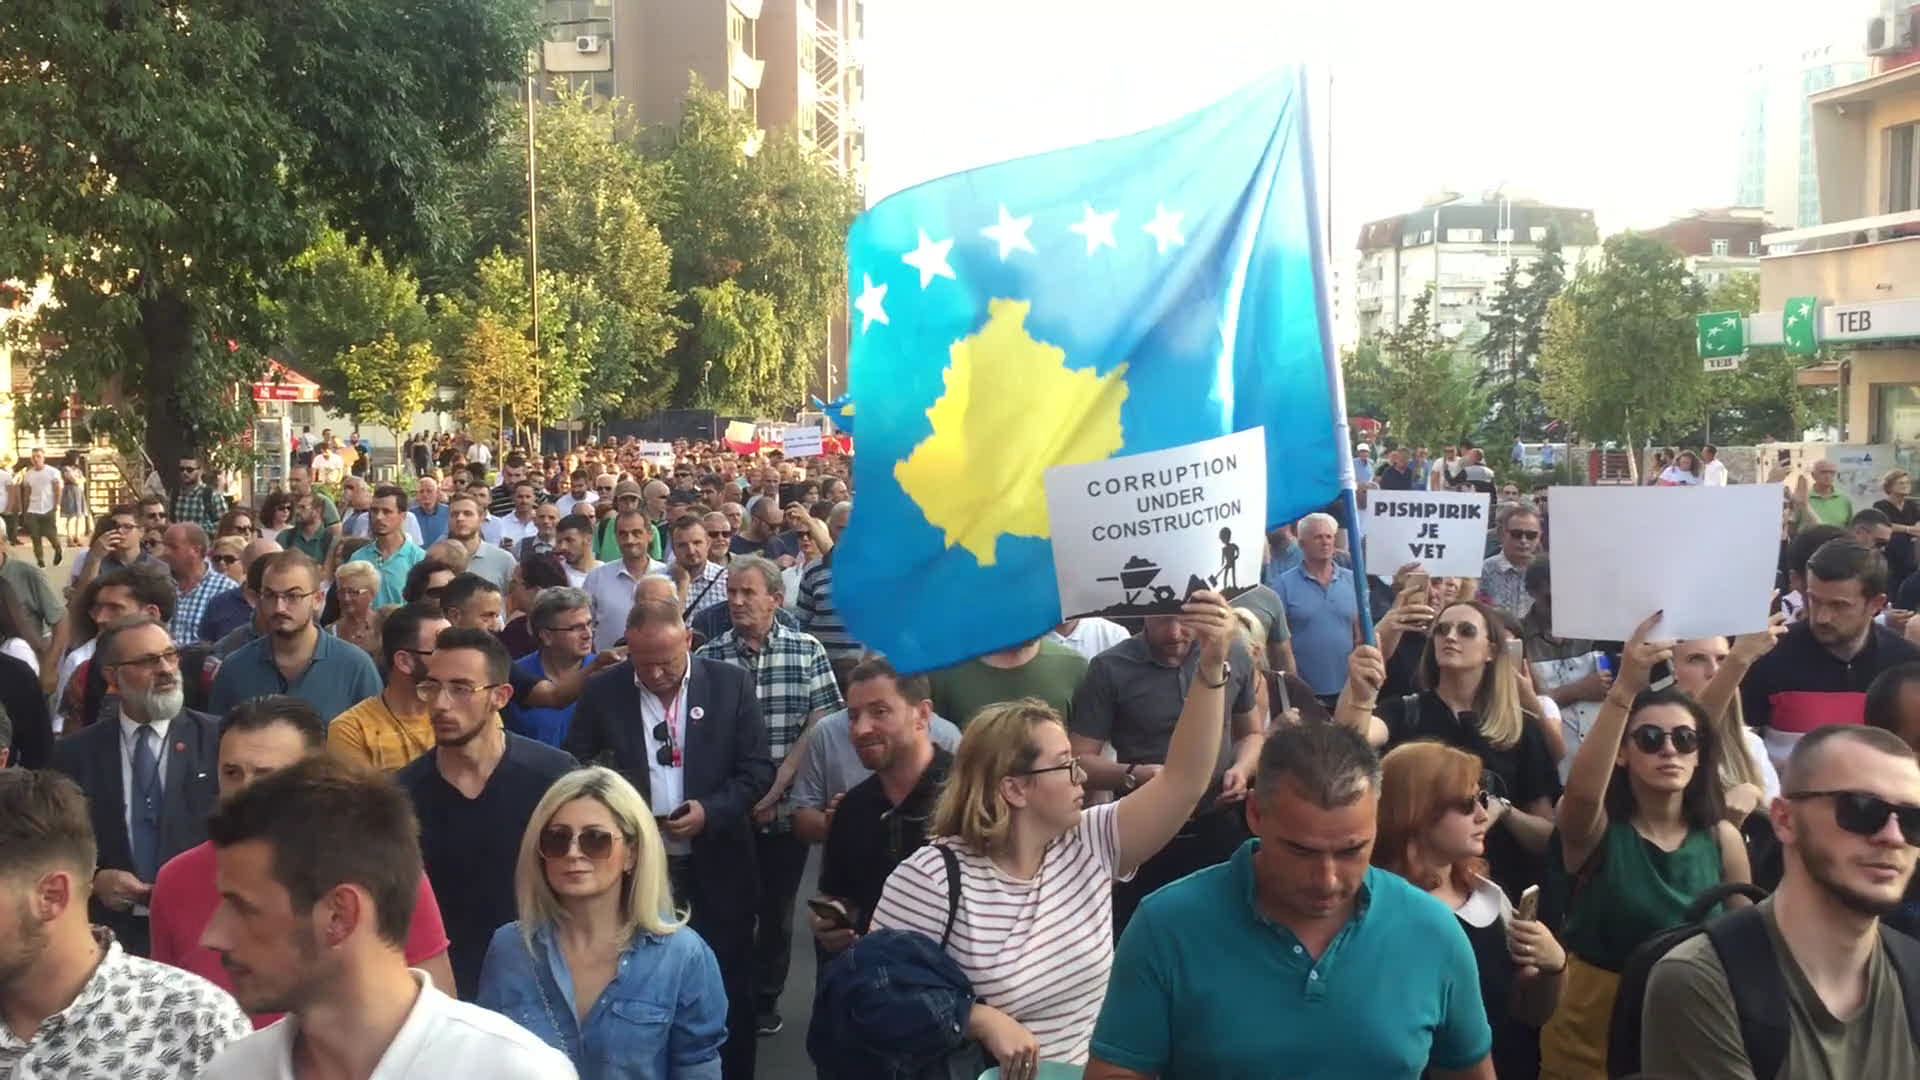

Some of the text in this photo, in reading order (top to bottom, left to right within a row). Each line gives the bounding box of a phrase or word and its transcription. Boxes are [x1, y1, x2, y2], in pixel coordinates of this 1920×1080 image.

[1837, 310, 1871, 332] TEB
[1087, 454, 1237, 497] CORRUPTION
[1137, 486, 1205, 513] UNDER
[1374, 502, 1480, 519] PISHPIRIK
[1092, 499, 1241, 541] CONSTRUCTION
[1417, 523, 1439, 538] JE
[1408, 543, 1446, 559] VET
